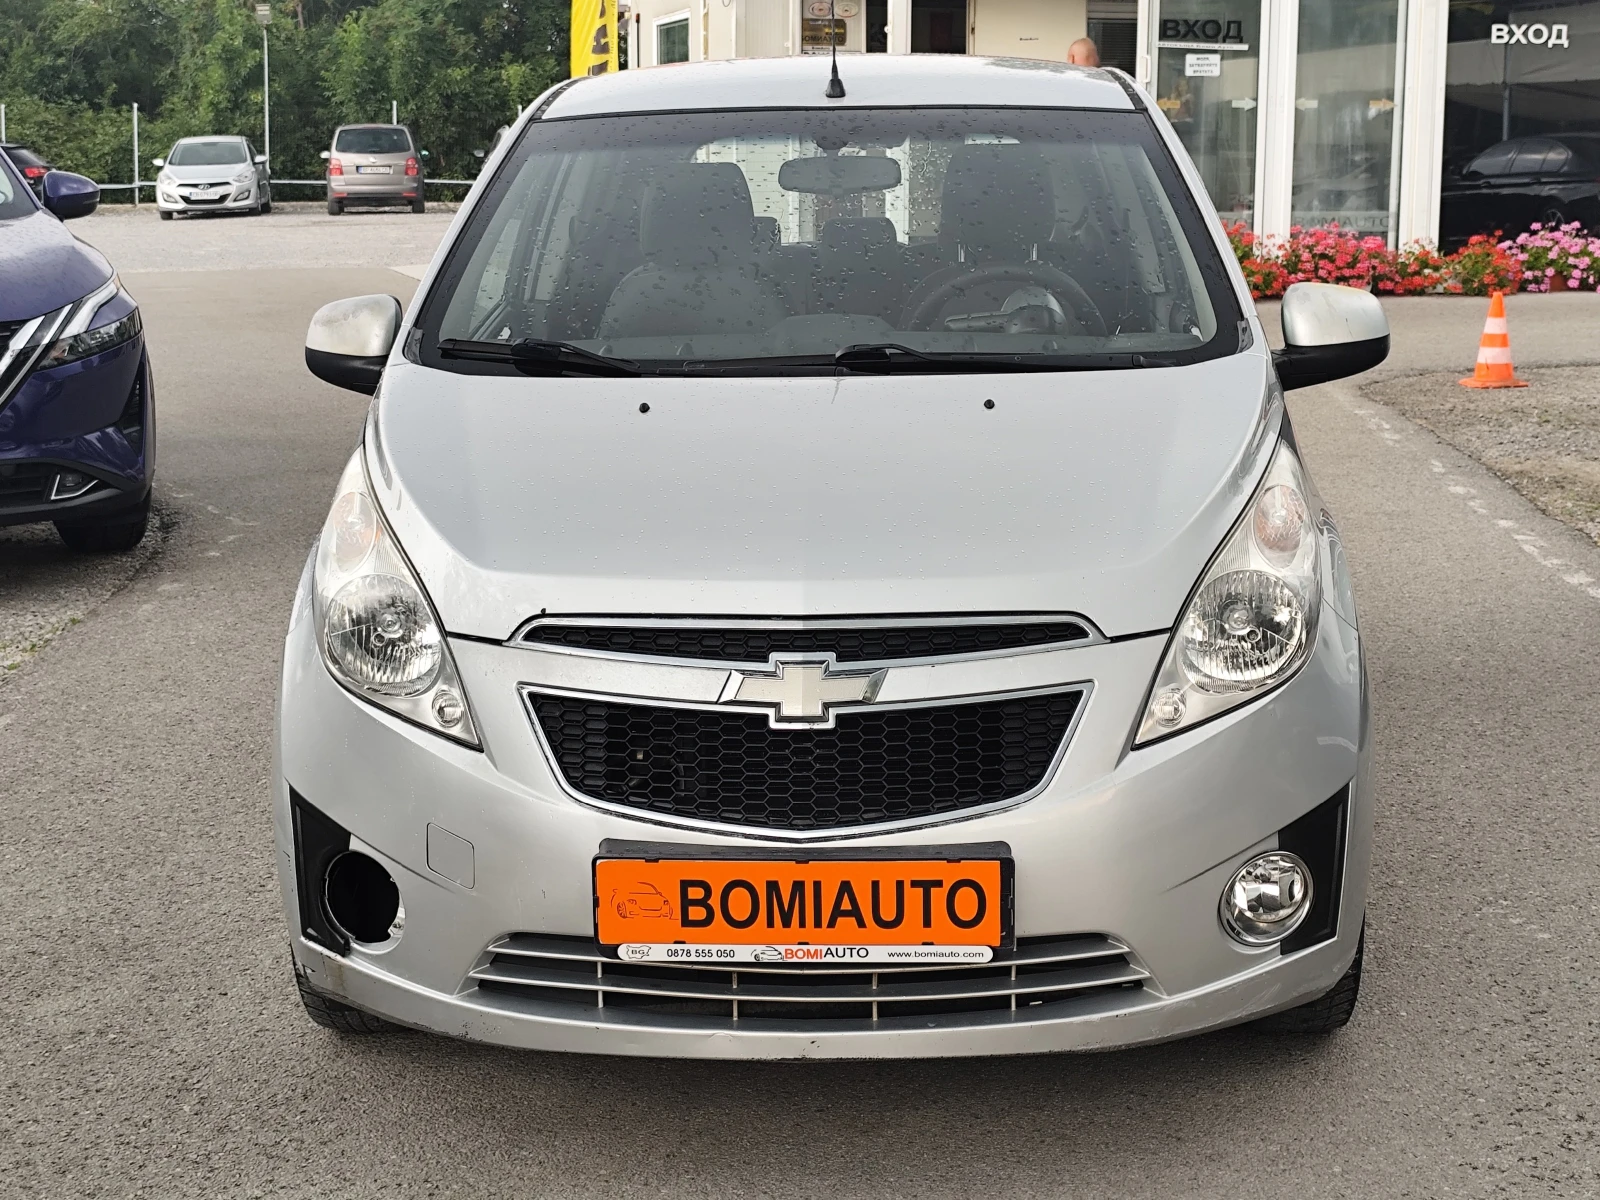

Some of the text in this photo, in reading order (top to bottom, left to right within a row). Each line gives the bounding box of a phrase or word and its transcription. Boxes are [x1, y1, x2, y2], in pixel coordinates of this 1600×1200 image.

[1162, 19, 1243, 43] ВХОД
[1491, 23, 1569, 48] ВХОД
[679, 878, 987, 930] BOMIAUTO
[666, 948, 692, 957] 0878
[694, 949, 713, 958] 555
[716, 949, 735, 958] 050
[784, 947, 869, 960] BOMIAUTO
[887, 950, 984, 958] www.bomiauto.com
